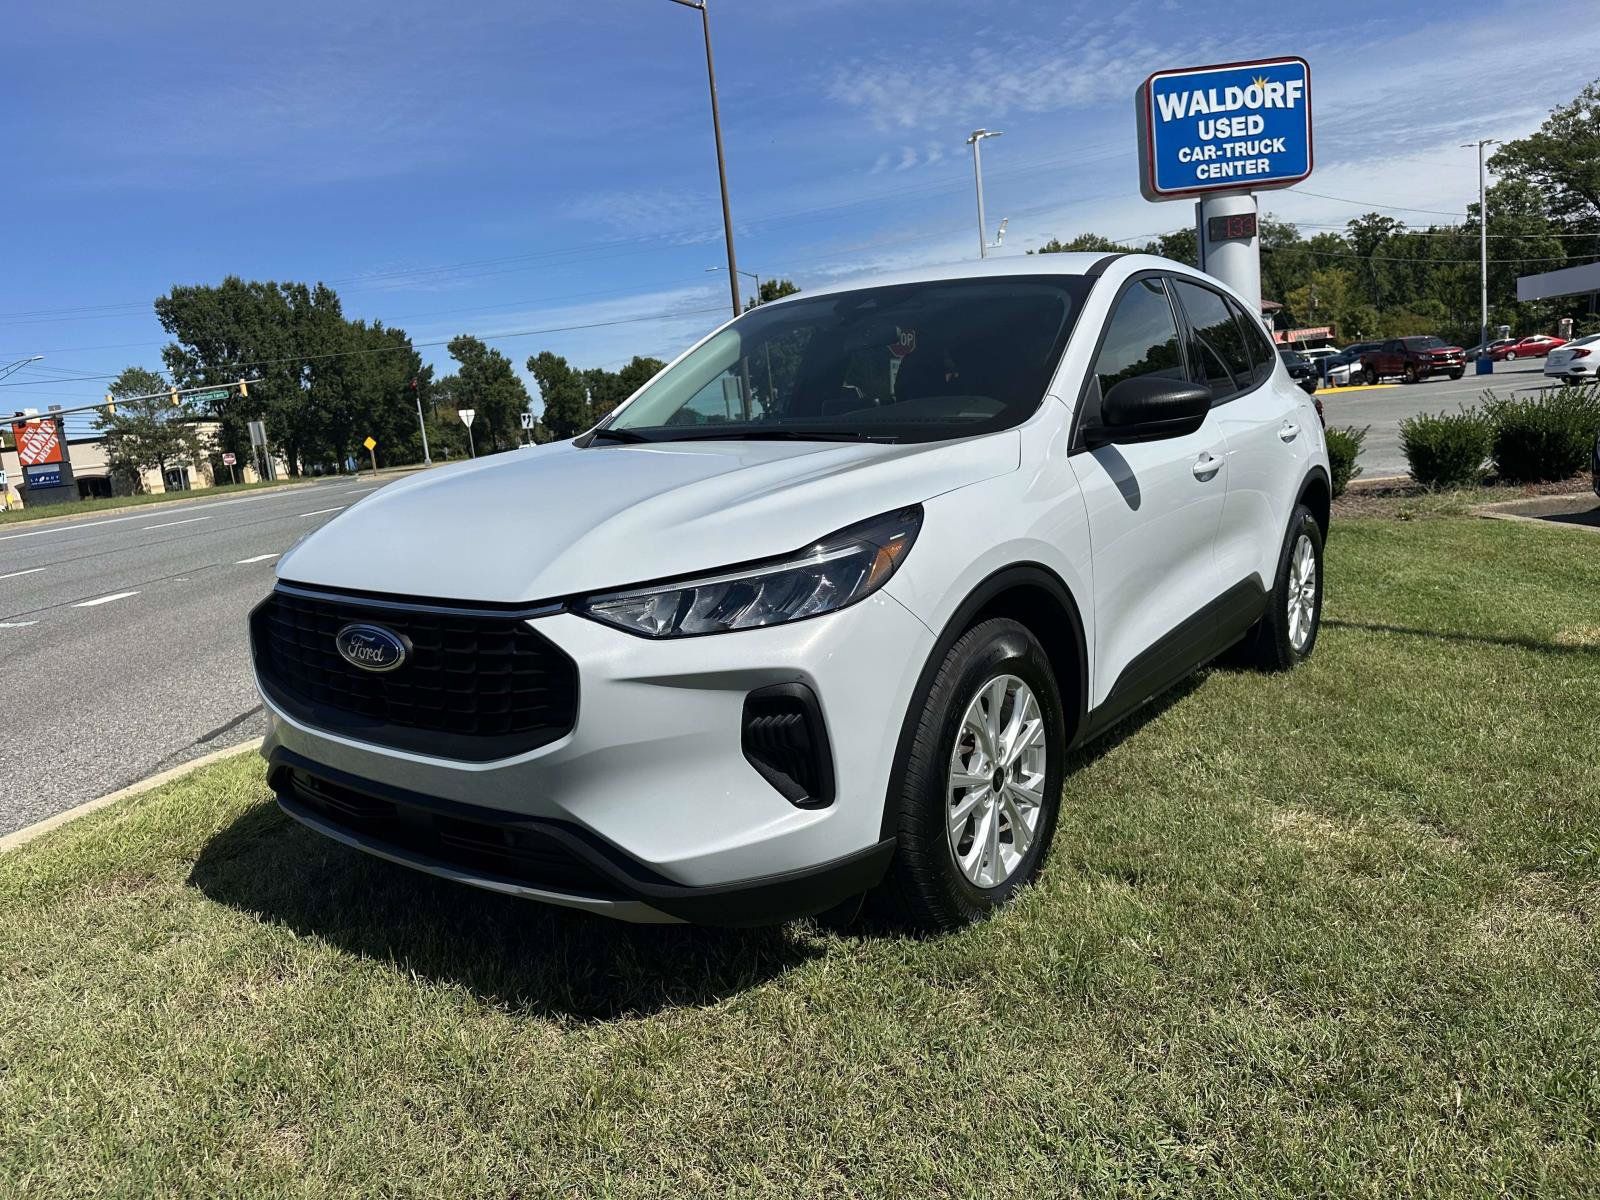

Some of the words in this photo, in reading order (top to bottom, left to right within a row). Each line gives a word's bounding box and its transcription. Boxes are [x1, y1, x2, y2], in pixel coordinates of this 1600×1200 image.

[1156, 79, 1303, 122] WALDORF
[1198, 114, 1265, 141] USED
[1178, 137, 1287, 163] CAR-TRUCK
[1196, 158, 1270, 180] CENTER
[20, 420, 56, 464] HOME
[36, 434, 59, 463] DEPOT
[348, 633, 385, 661] Ford
